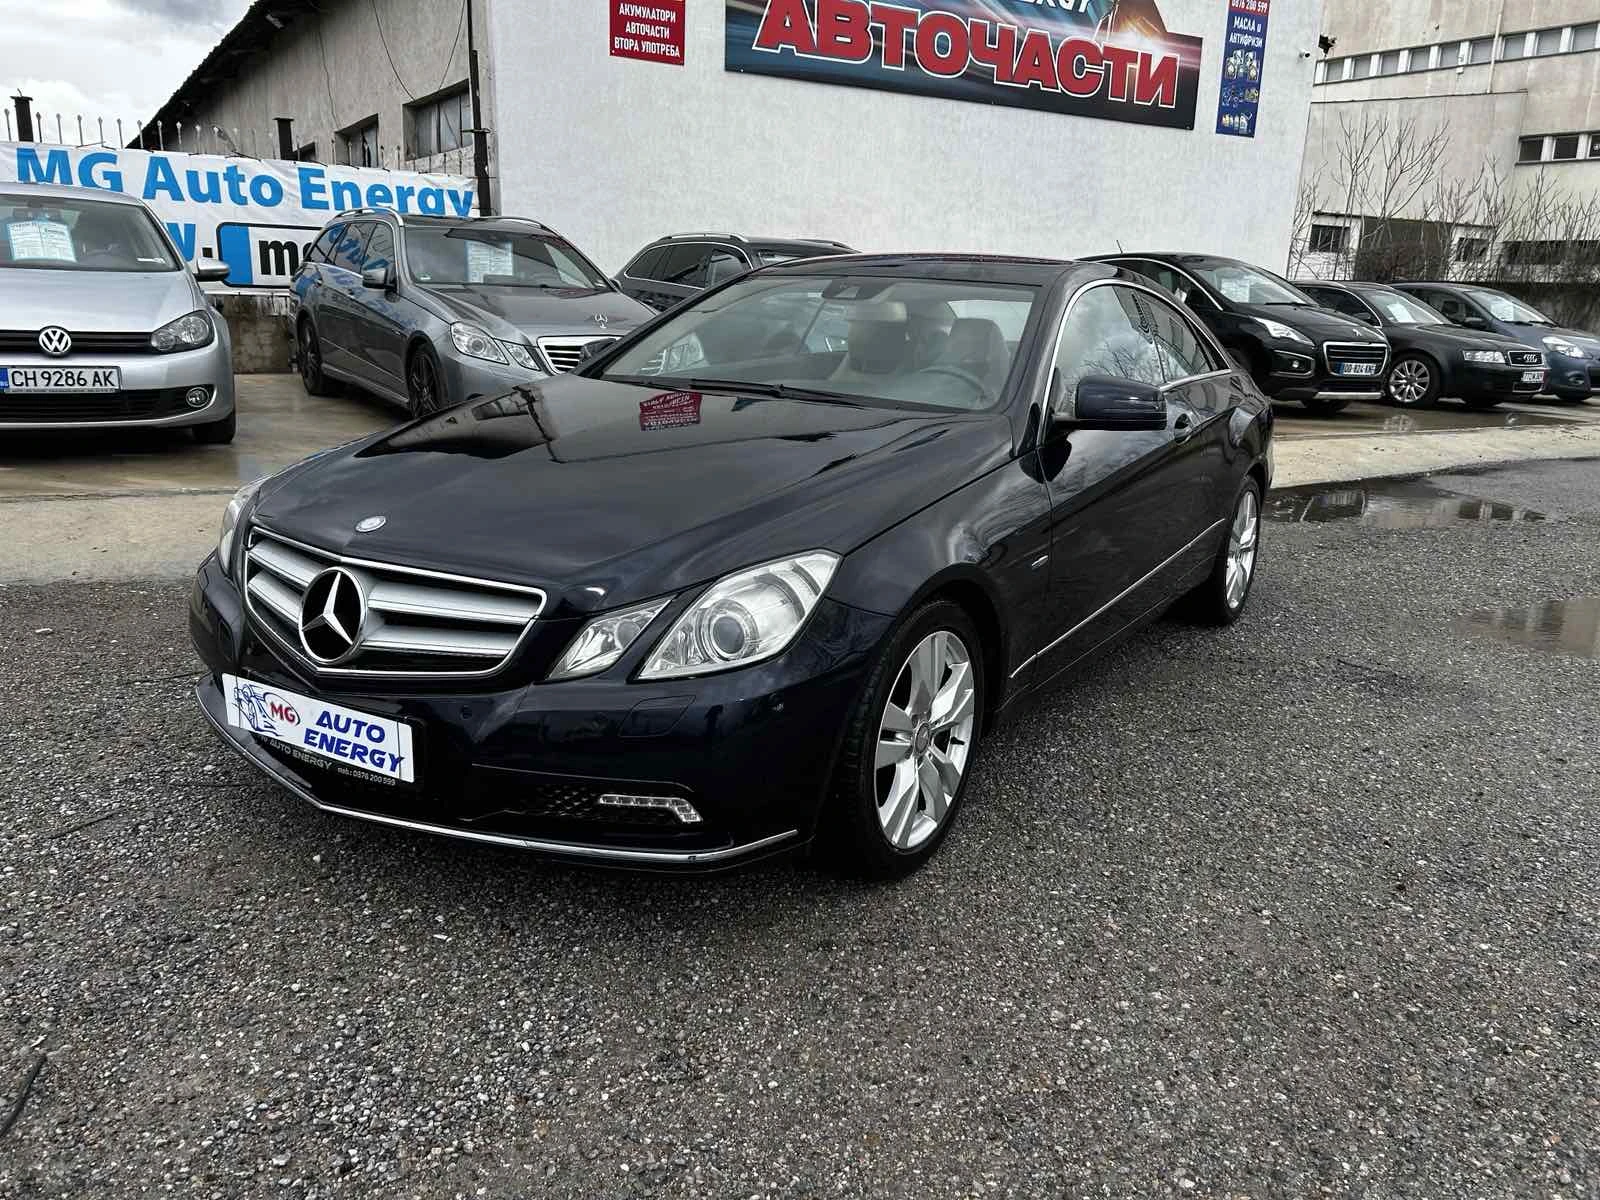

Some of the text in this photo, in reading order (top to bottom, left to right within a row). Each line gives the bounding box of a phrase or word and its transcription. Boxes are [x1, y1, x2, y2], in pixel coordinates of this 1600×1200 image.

[619, 3, 676, 23] АКУМУЛАТОРИ
[1233, 15, 1256, 32] МАСЛА
[625, 21, 670, 39] АВТОЧАСТИ
[1229, 32, 1263, 48] АНТИФРИЗИ
[614, 36, 681, 57] ВТОРА УПОТРЕБА
[752, 0, 1180, 107] АВТОЧАСТИ
[16, 148, 473, 217] MG Auto Energy
[11, 370, 38, 387] CH
[41, 370, 87, 387] 9286
[92, 370, 115, 387] AK
[268, 701, 296, 724] MG
[315, 710, 386, 743] AUTO
[269, 740, 291, 754] AUTO
[292, 749, 333, 770] ENERGY
[303, 728, 405, 773] ENERGY
